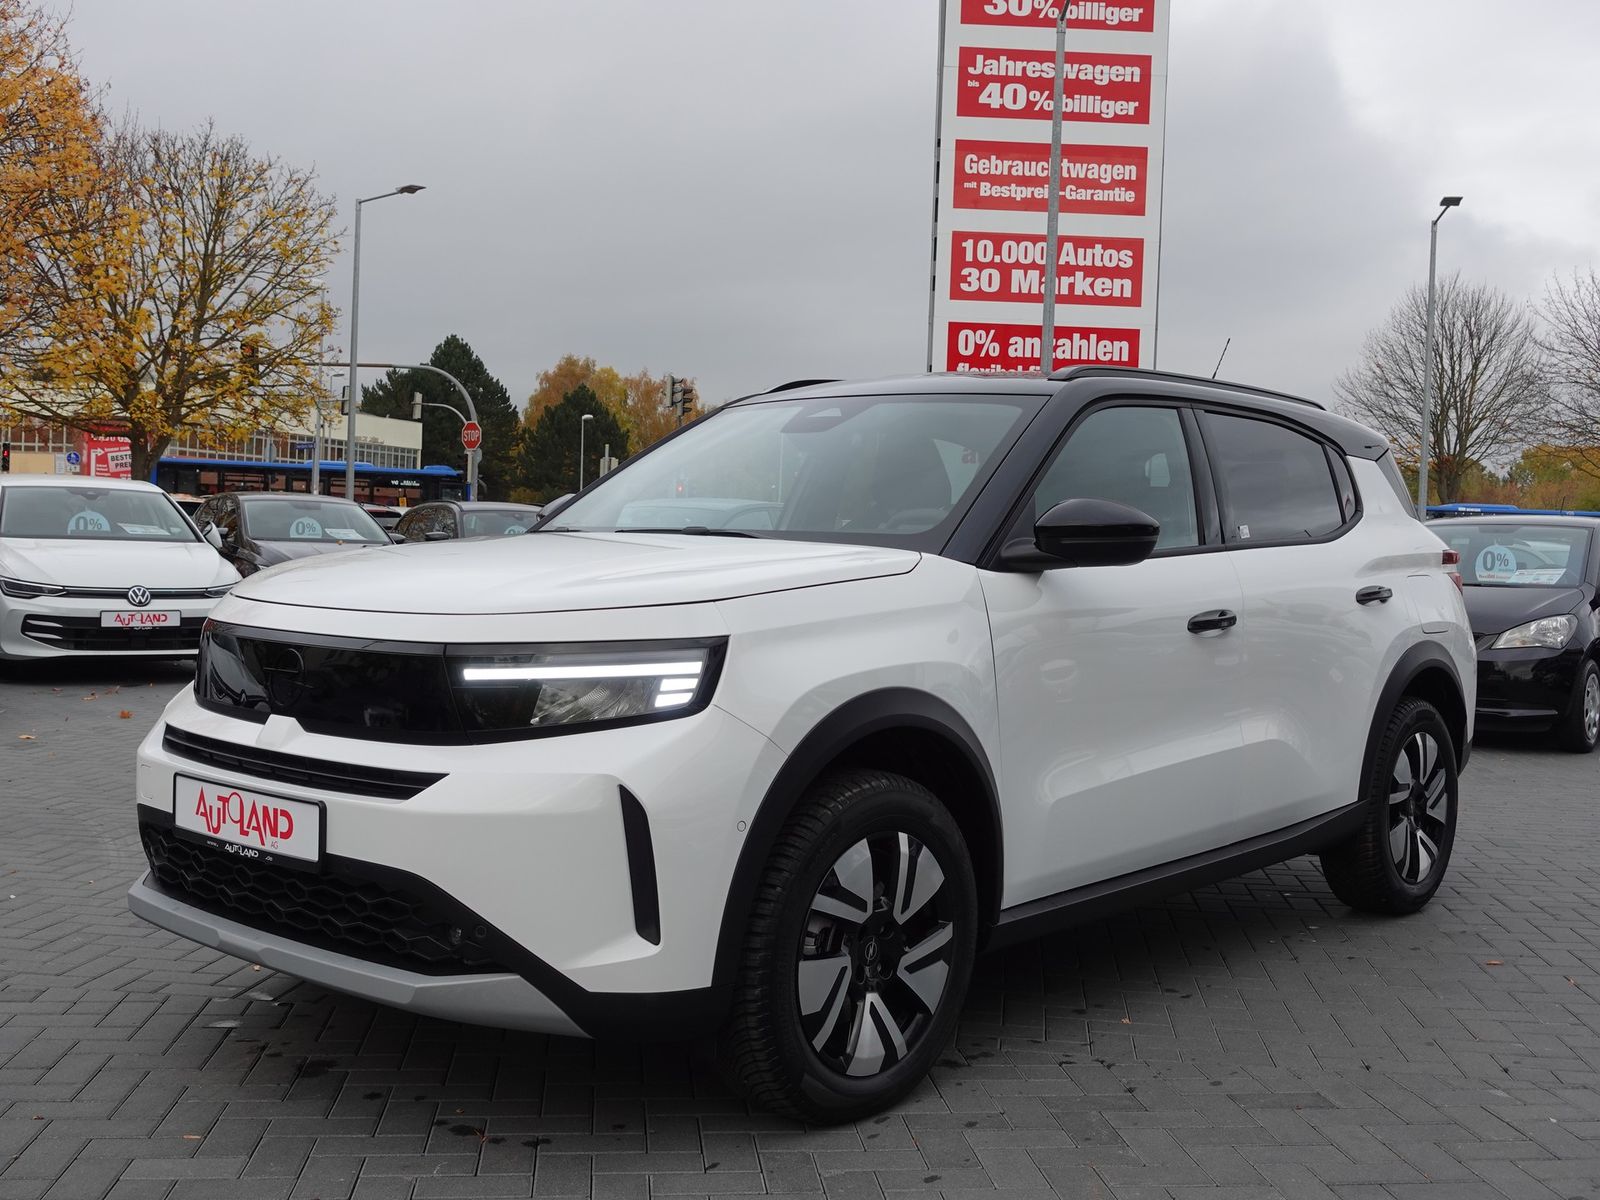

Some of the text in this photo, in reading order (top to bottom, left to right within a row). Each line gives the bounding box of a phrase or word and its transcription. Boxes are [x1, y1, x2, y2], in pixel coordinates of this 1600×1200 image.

[1066, 1, 1143, 26] billiger
[967, 55, 1141, 85] Jahreswagen
[978, 83, 1139, 119] 40% billiger
[964, 154, 1137, 183] Gebrauctwagen
[980, 182, 1135, 203] Bestprei-Garantie
[961, 239, 1133, 269] 10.000 Autos
[960, 267, 1001, 292] 30
[957, 329, 1129, 362] 0% anahlen
[464, 430, 480, 441] STOP
[295, 521, 316, 535] 0%
[1482, 551, 1509, 571] 0%
[195, 786, 294, 846] AUTOLAND
